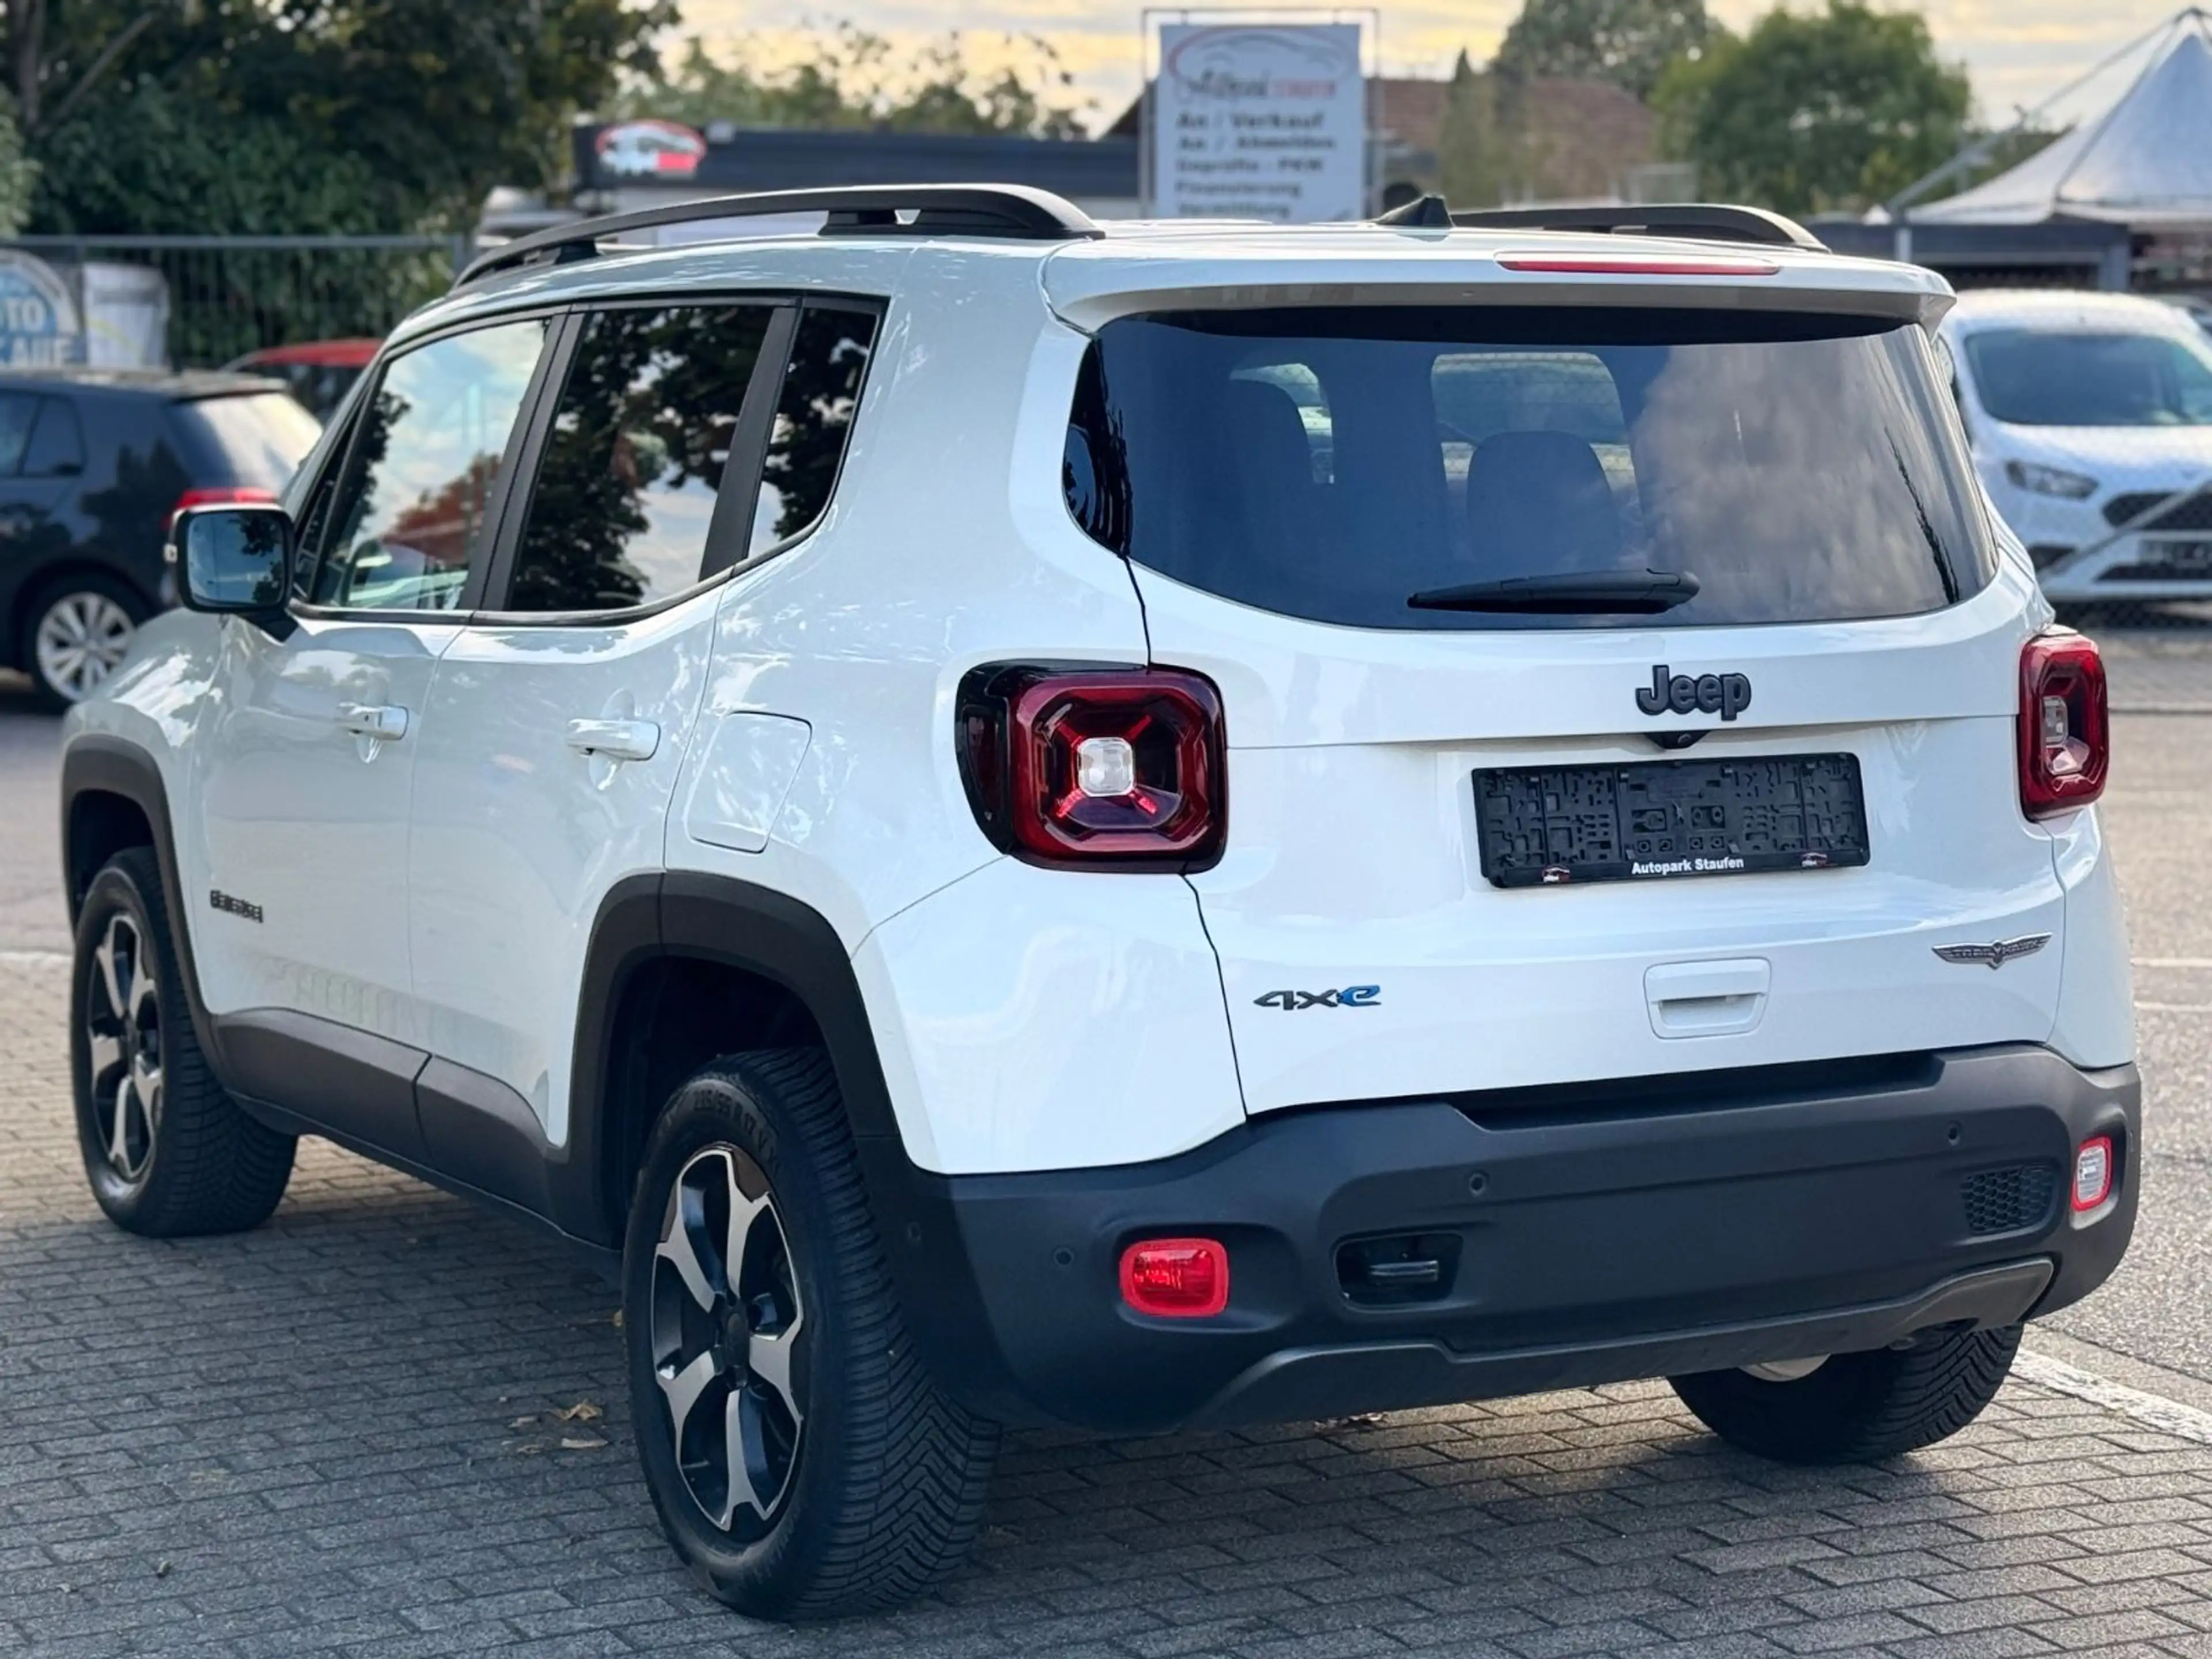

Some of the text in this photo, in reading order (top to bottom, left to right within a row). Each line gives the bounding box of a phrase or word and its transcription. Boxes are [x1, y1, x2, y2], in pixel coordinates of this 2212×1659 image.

[1177, 114, 1208, 128] An
[1229, 111, 1324, 128] Verkauf
[1635, 664, 1752, 721] Jeep
[1631, 856, 1744, 876] Autopark Staufen
